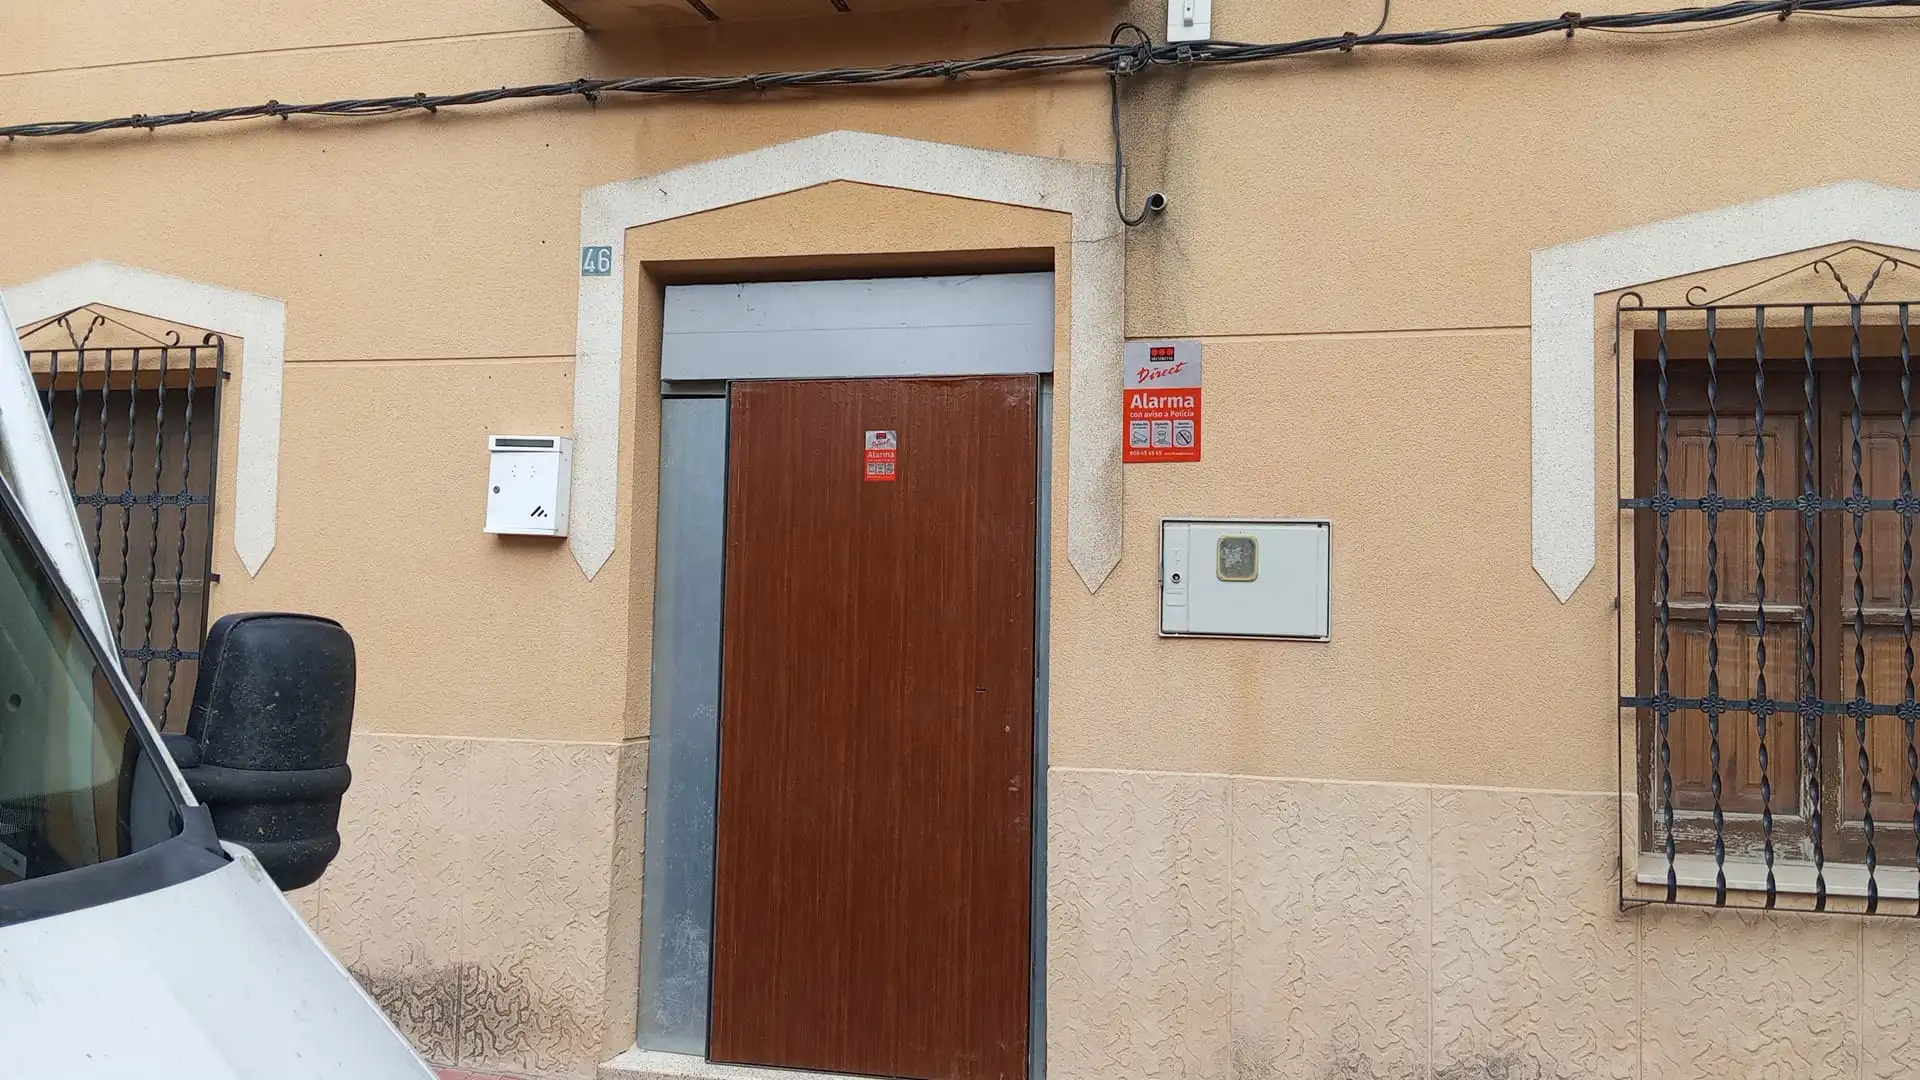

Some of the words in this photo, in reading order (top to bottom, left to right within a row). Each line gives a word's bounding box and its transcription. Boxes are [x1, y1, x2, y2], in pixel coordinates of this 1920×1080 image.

[584, 248, 610, 272] 46
[1136, 361, 1189, 384] Direct
[1130, 392, 1194, 409] Alarma
[1144, 410, 1163, 418] aviso
